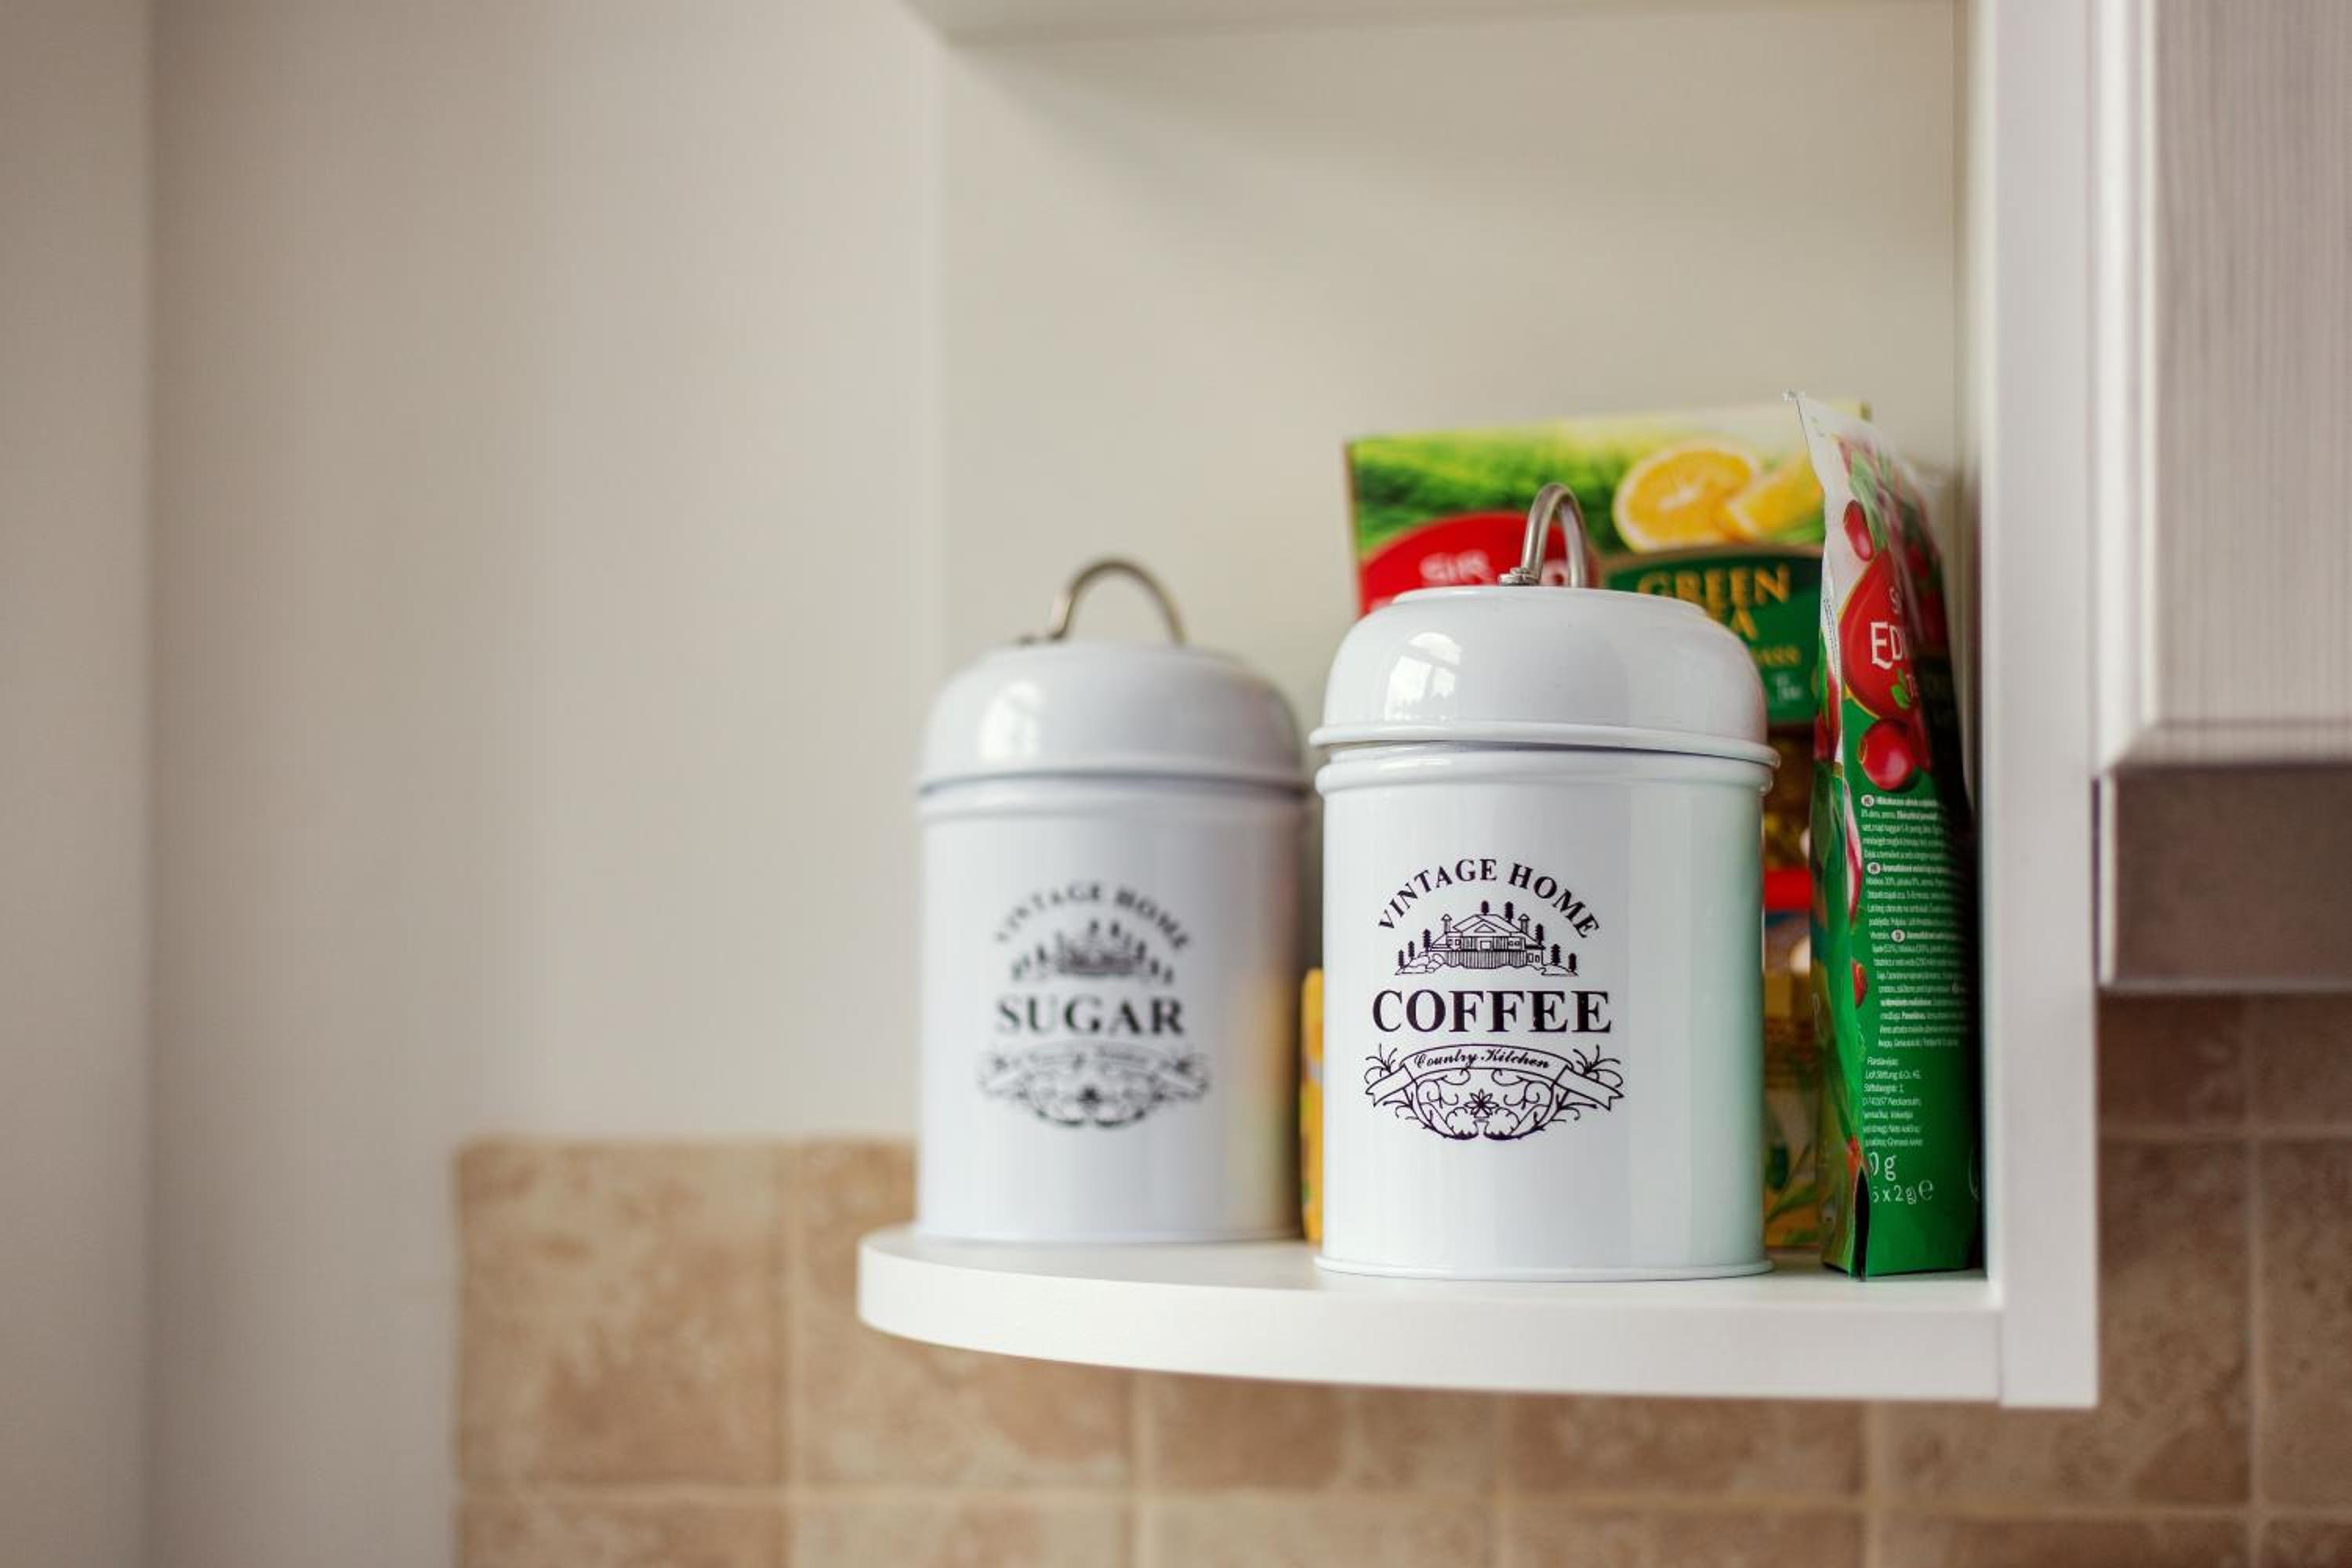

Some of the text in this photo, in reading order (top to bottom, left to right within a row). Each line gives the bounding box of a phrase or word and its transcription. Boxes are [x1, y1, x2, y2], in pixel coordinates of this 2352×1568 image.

[1637, 564, 1790, 605] GREEN
[996, 883, 1190, 950] VINTAGE HOME
[1378, 858, 1600, 939] VINTAGE HOME
[996, 993, 1185, 1036] SUGAR
[1372, 988, 1612, 1034] COFFEE
[1414, 1048, 1550, 1070] Country Kitchen
[1884, 1155, 1897, 1182] g
